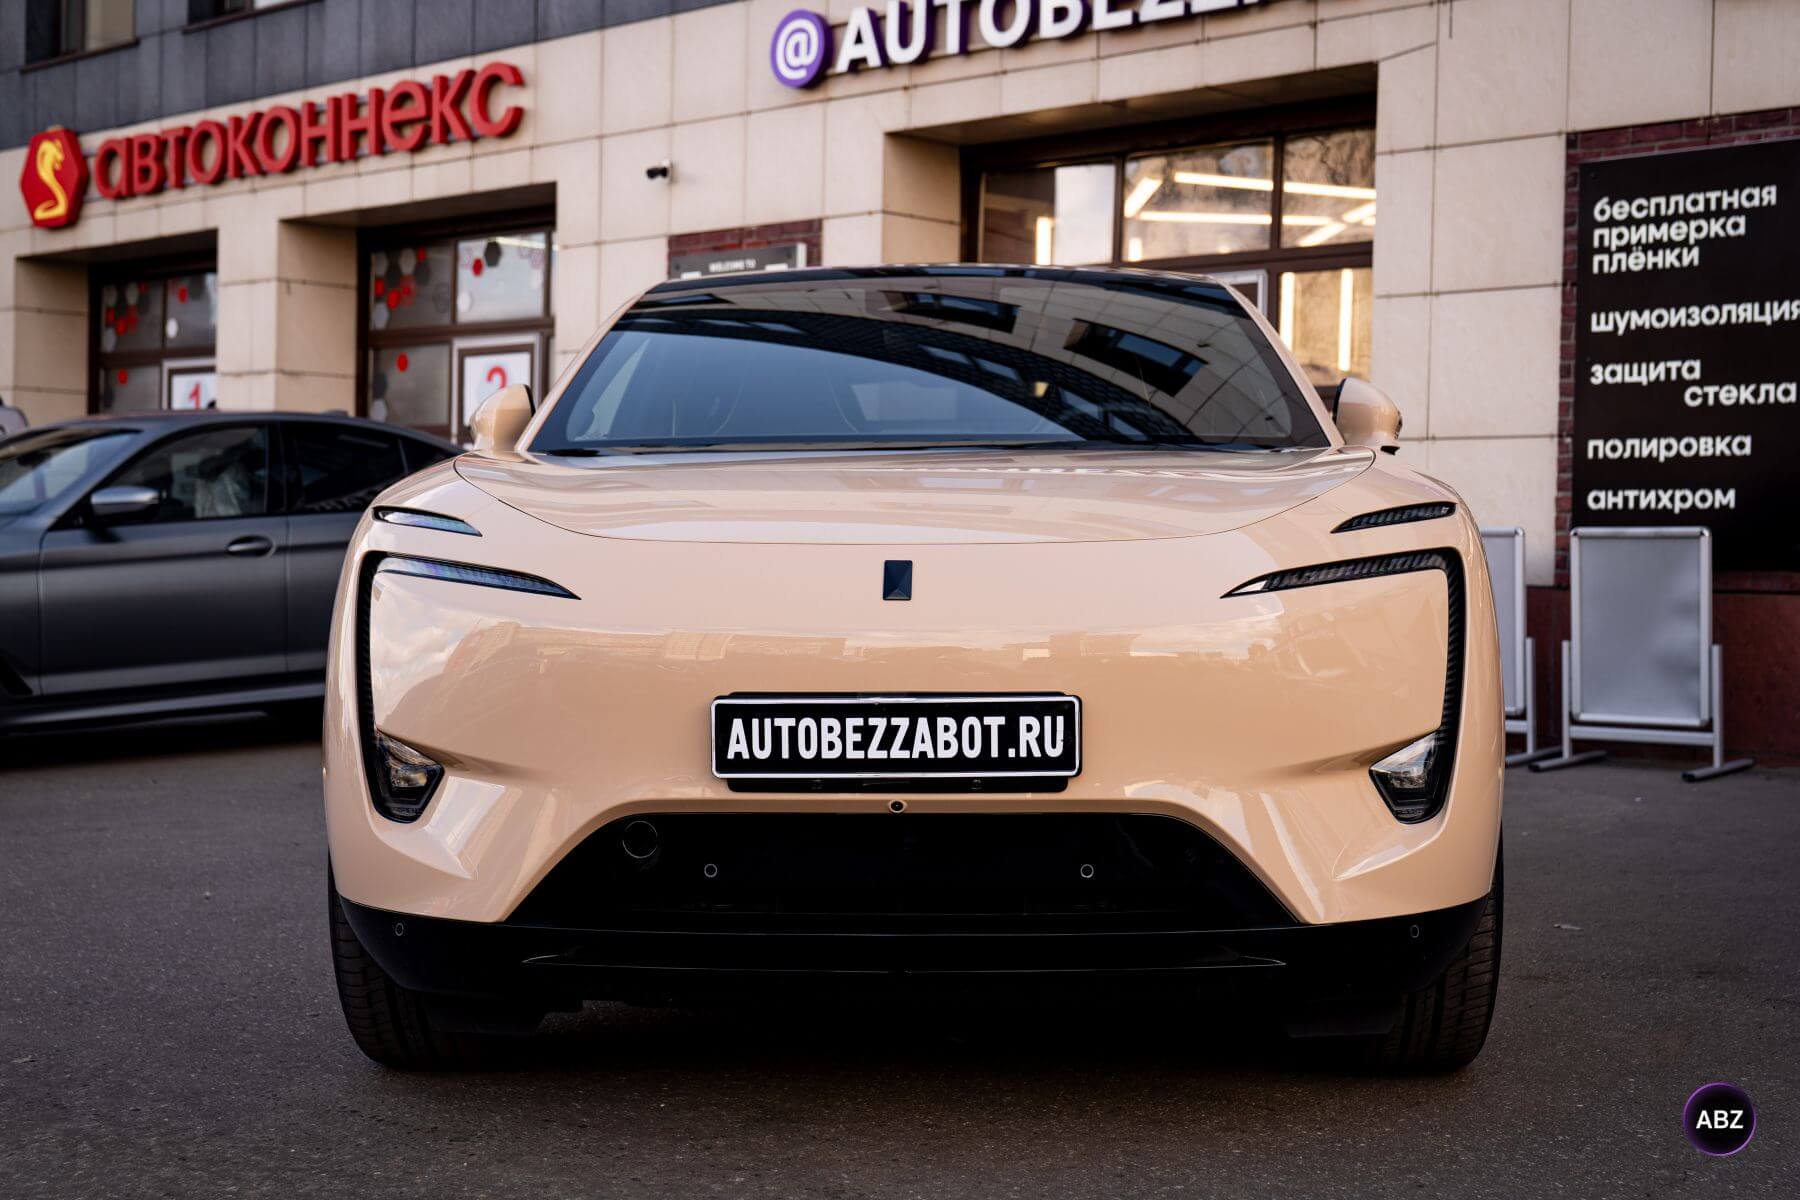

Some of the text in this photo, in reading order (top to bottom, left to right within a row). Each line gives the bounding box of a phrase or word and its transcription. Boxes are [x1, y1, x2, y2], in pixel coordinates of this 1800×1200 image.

[93, 61, 525, 200] автоконнекс
[1593, 185, 1778, 222] бесплатная
[1593, 214, 1747, 252] примерка
[1592, 245, 1700, 275] плёнки
[1590, 299, 1800, 337] шумоизоляция
[1589, 359, 1701, 387] защита
[1683, 382, 1797, 408] стекла
[1587, 435, 1752, 463] полировка
[1586, 488, 1736, 514] антихром
[727, 715, 1065, 760] AUTOBEZZABOT.RU
